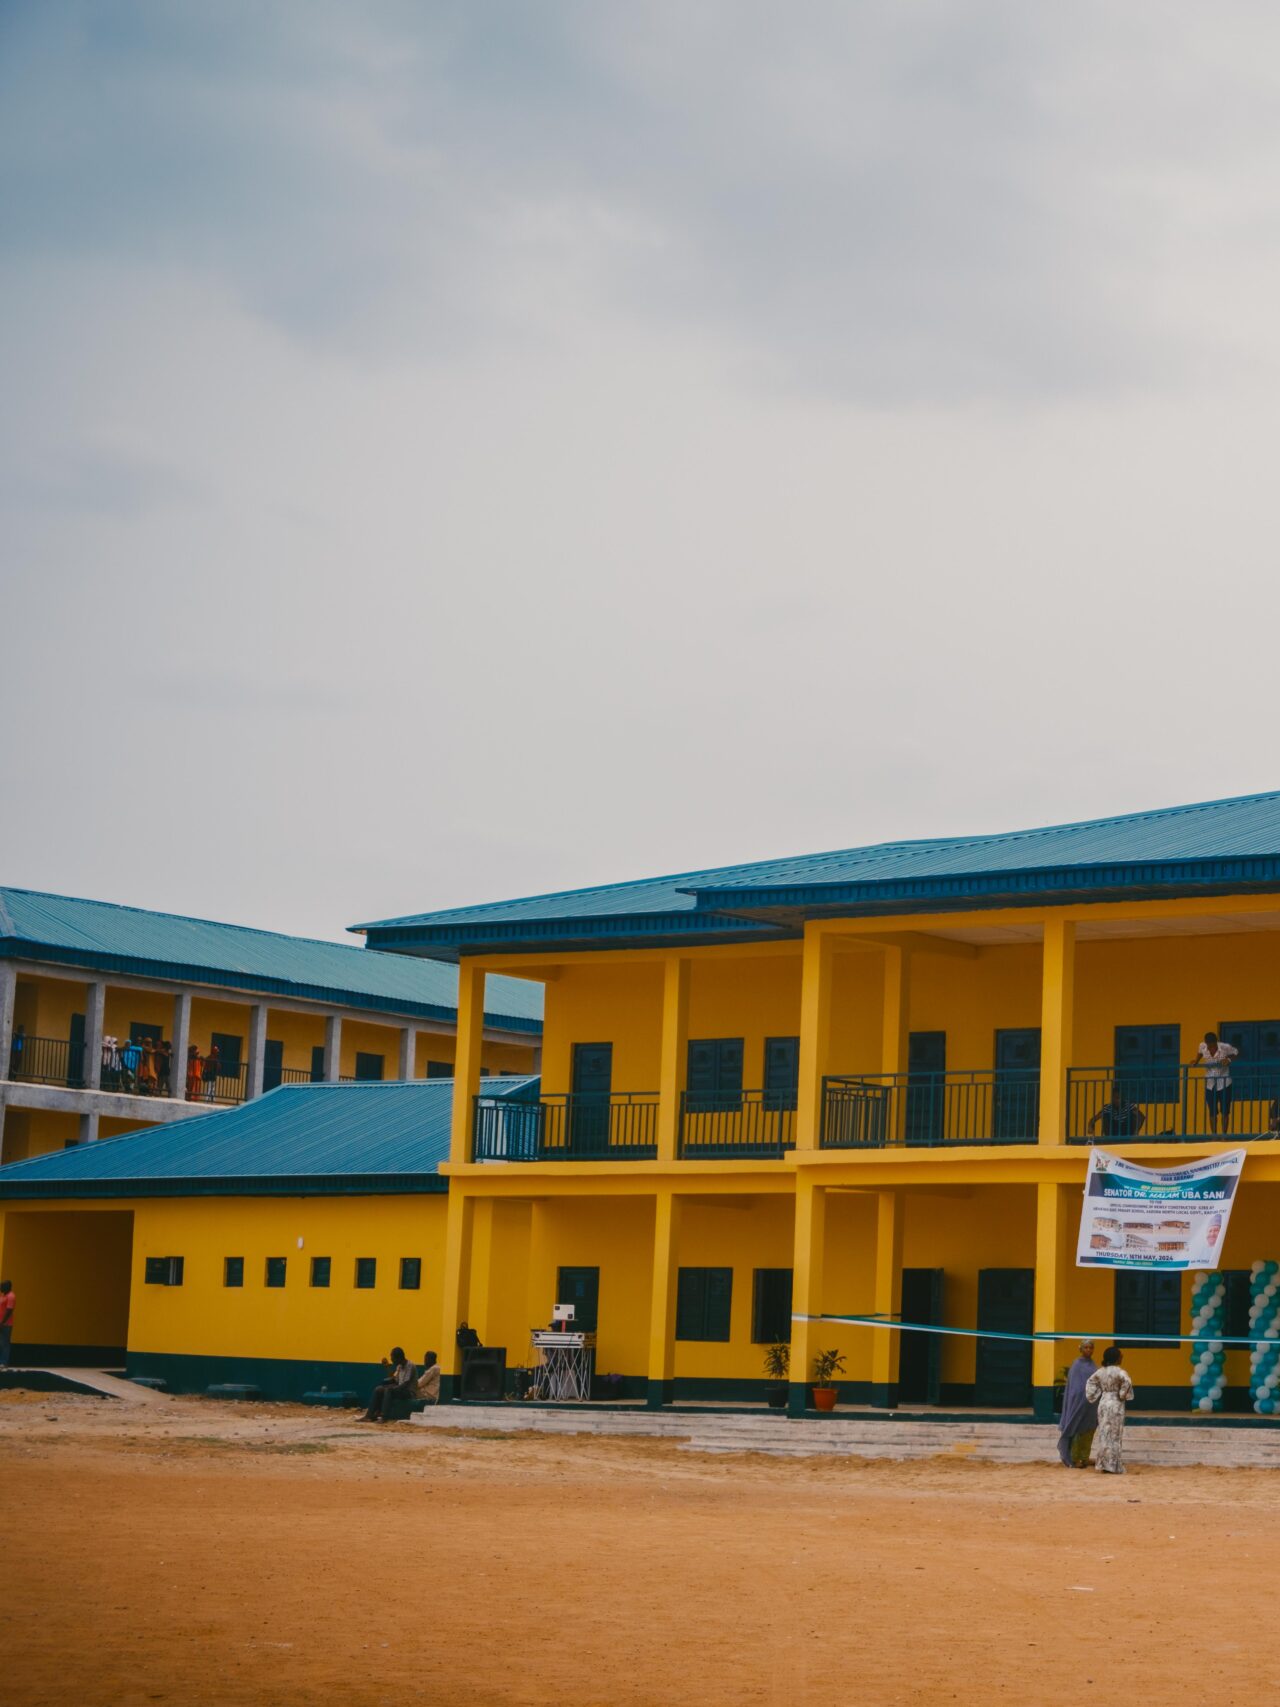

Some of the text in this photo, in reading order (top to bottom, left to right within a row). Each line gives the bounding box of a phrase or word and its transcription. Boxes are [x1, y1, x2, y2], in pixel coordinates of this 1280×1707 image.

[1104, 1188, 1133, 1197] SENATOR
[1134, 1189, 1147, 1198] DR.
[1149, 1191, 1180, 1199] MALAM
[1182, 1191, 1201, 1199] UBA
[1203, 1191, 1225, 1199] SANI
[1096, 1251, 1128, 1259] THURSDAY,
